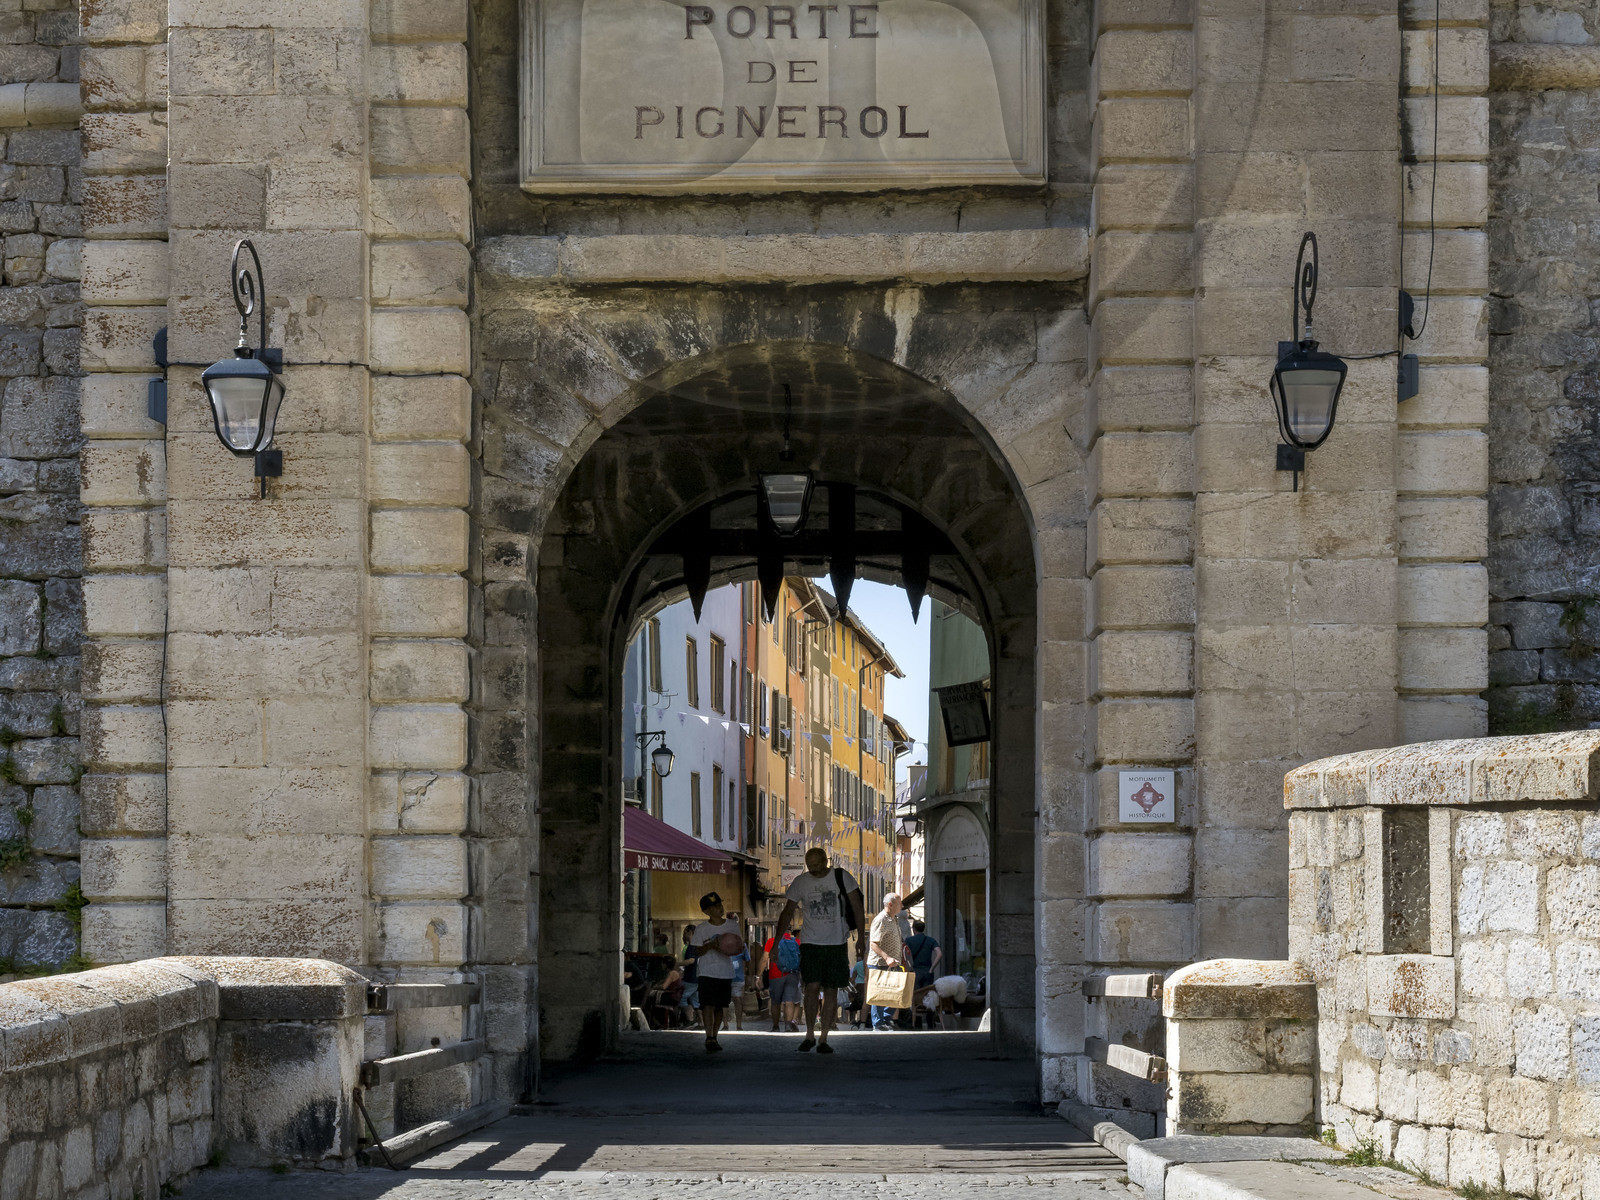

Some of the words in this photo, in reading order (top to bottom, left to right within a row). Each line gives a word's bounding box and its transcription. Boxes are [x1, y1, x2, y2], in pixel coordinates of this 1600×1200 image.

[683, 4, 881, 41] PORTE
[746, 59, 819, 85] DE
[633, 104, 931, 141] PIGNEROL
[637, 854, 649, 869] BAR
[651, 857, 669, 871] SNACK
